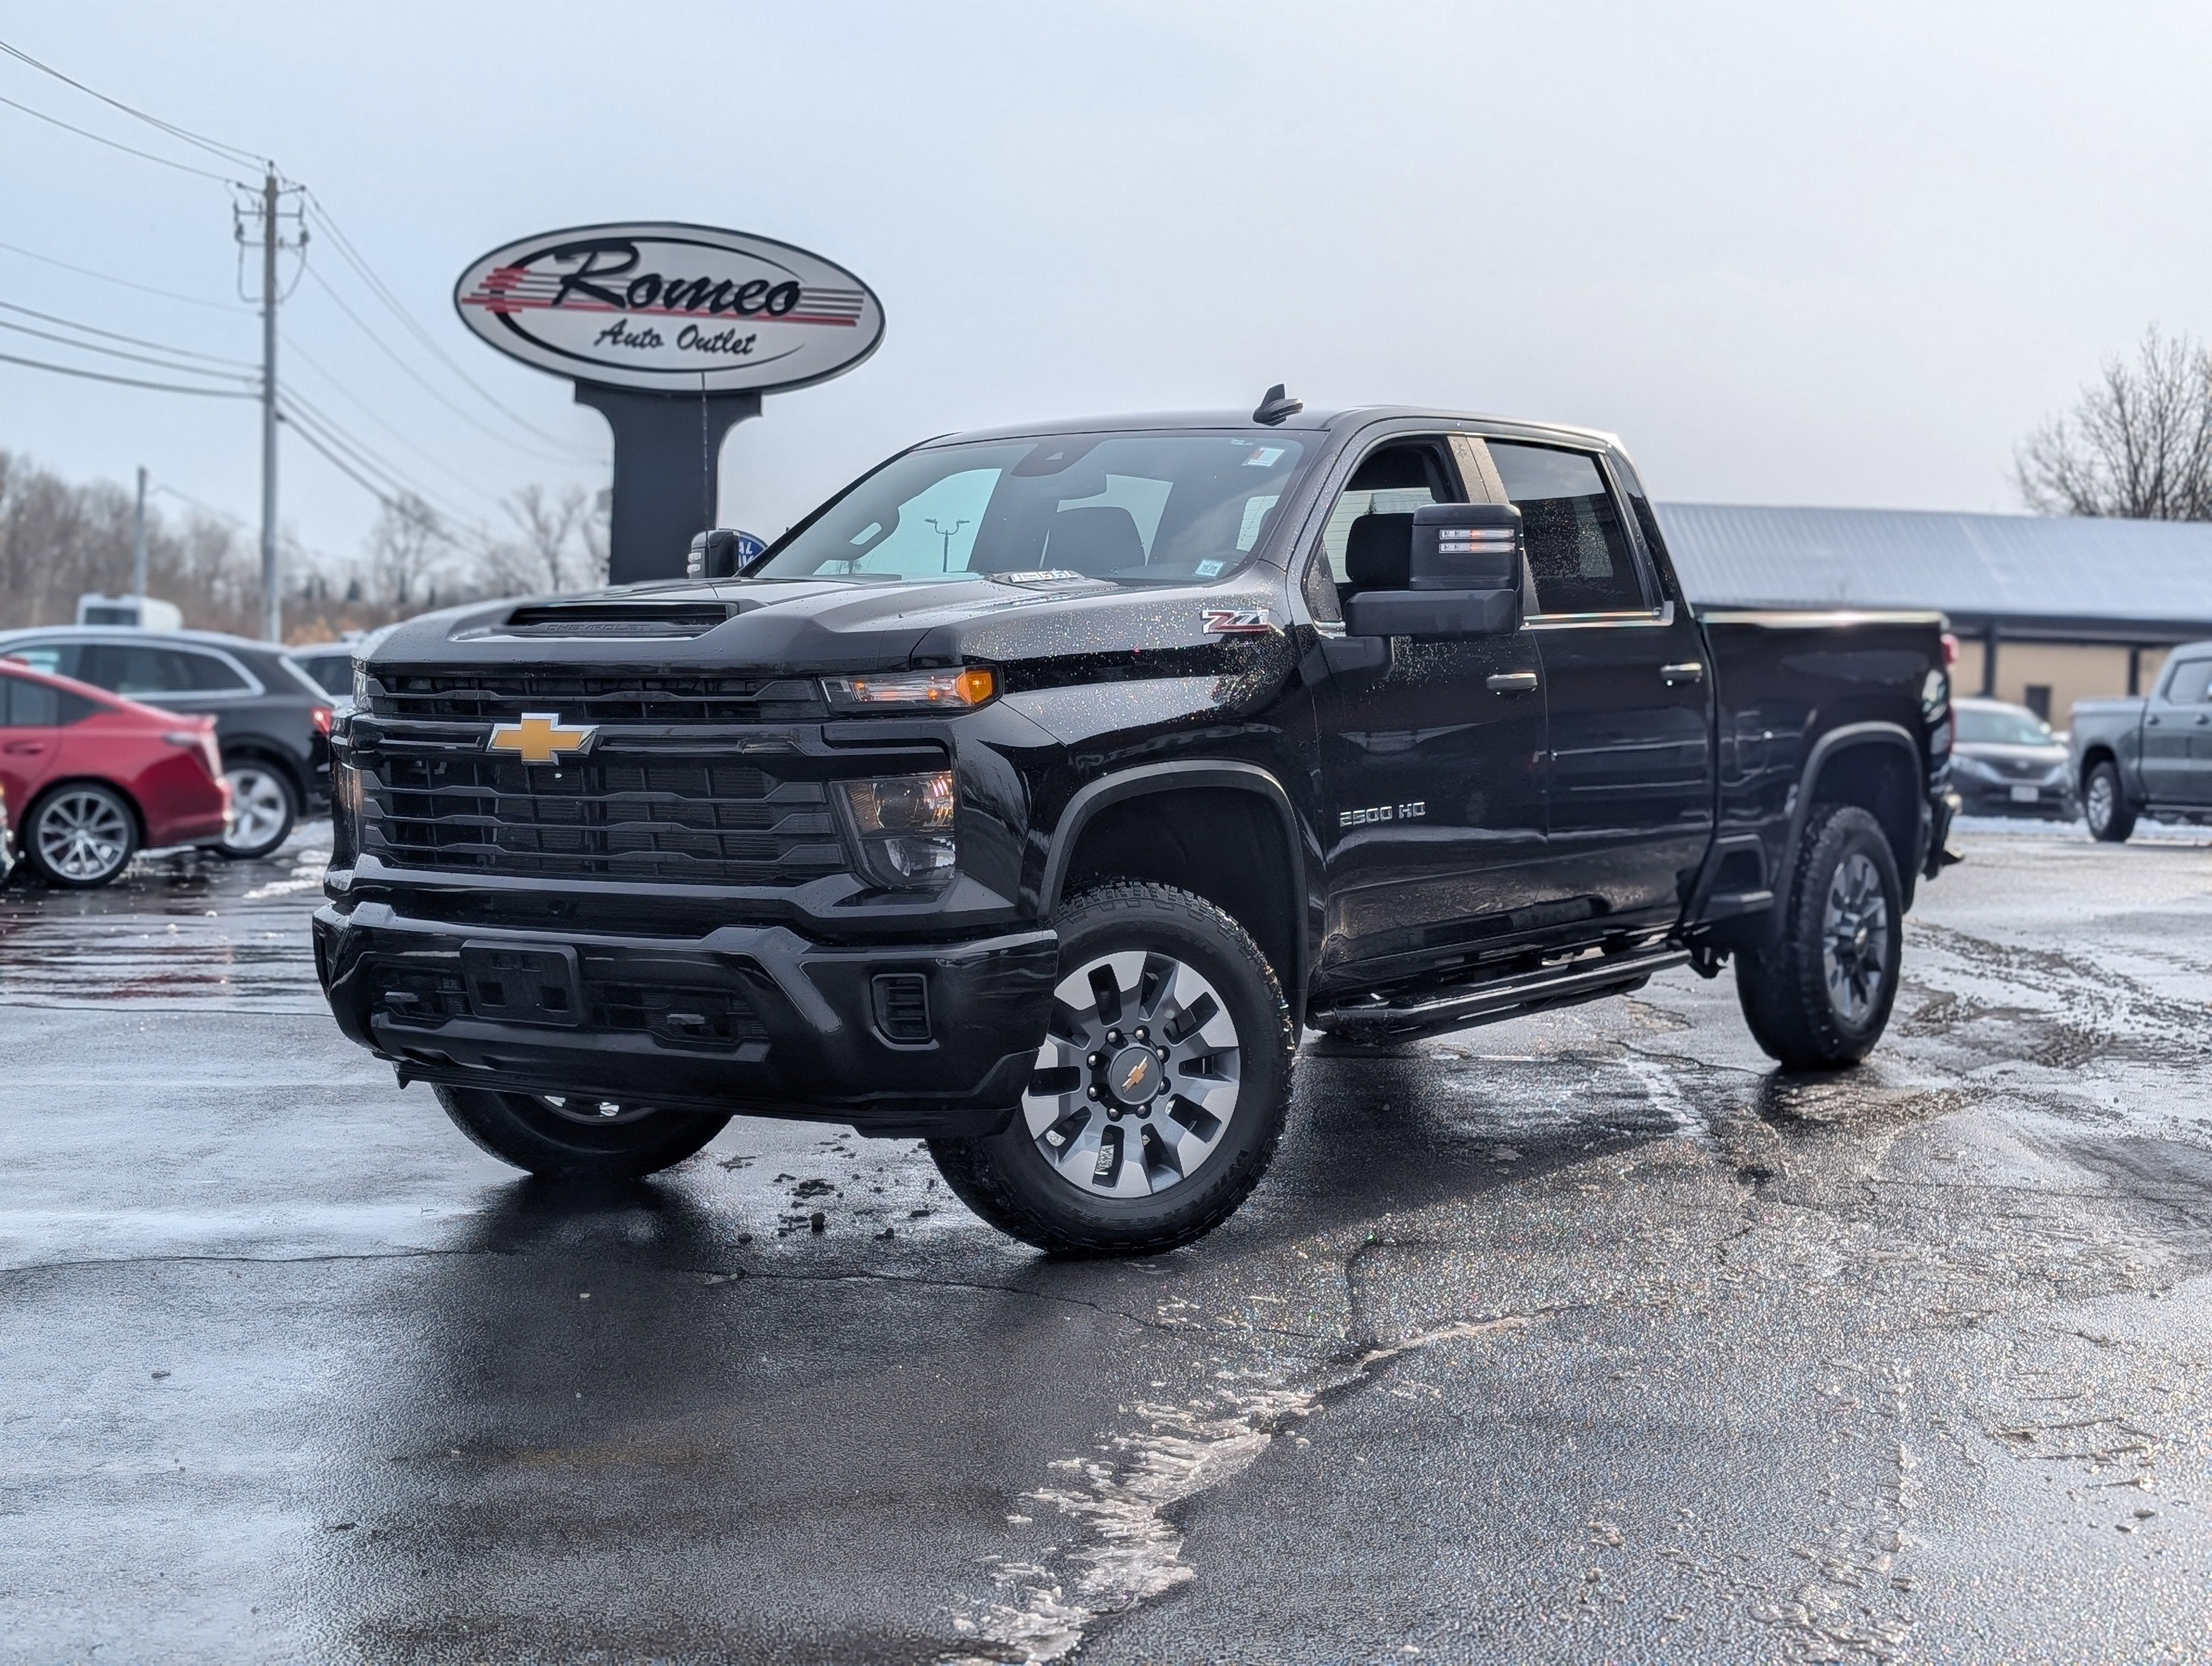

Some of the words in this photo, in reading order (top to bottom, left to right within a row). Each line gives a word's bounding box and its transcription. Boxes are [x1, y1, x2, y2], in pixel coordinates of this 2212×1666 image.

[552, 239, 801, 316] Romeo
[594, 318, 664, 350] Auto
[677, 324, 757, 355] Outlet
[1340, 806, 1392, 827] 2500
[1399, 802, 1426, 818] HD
